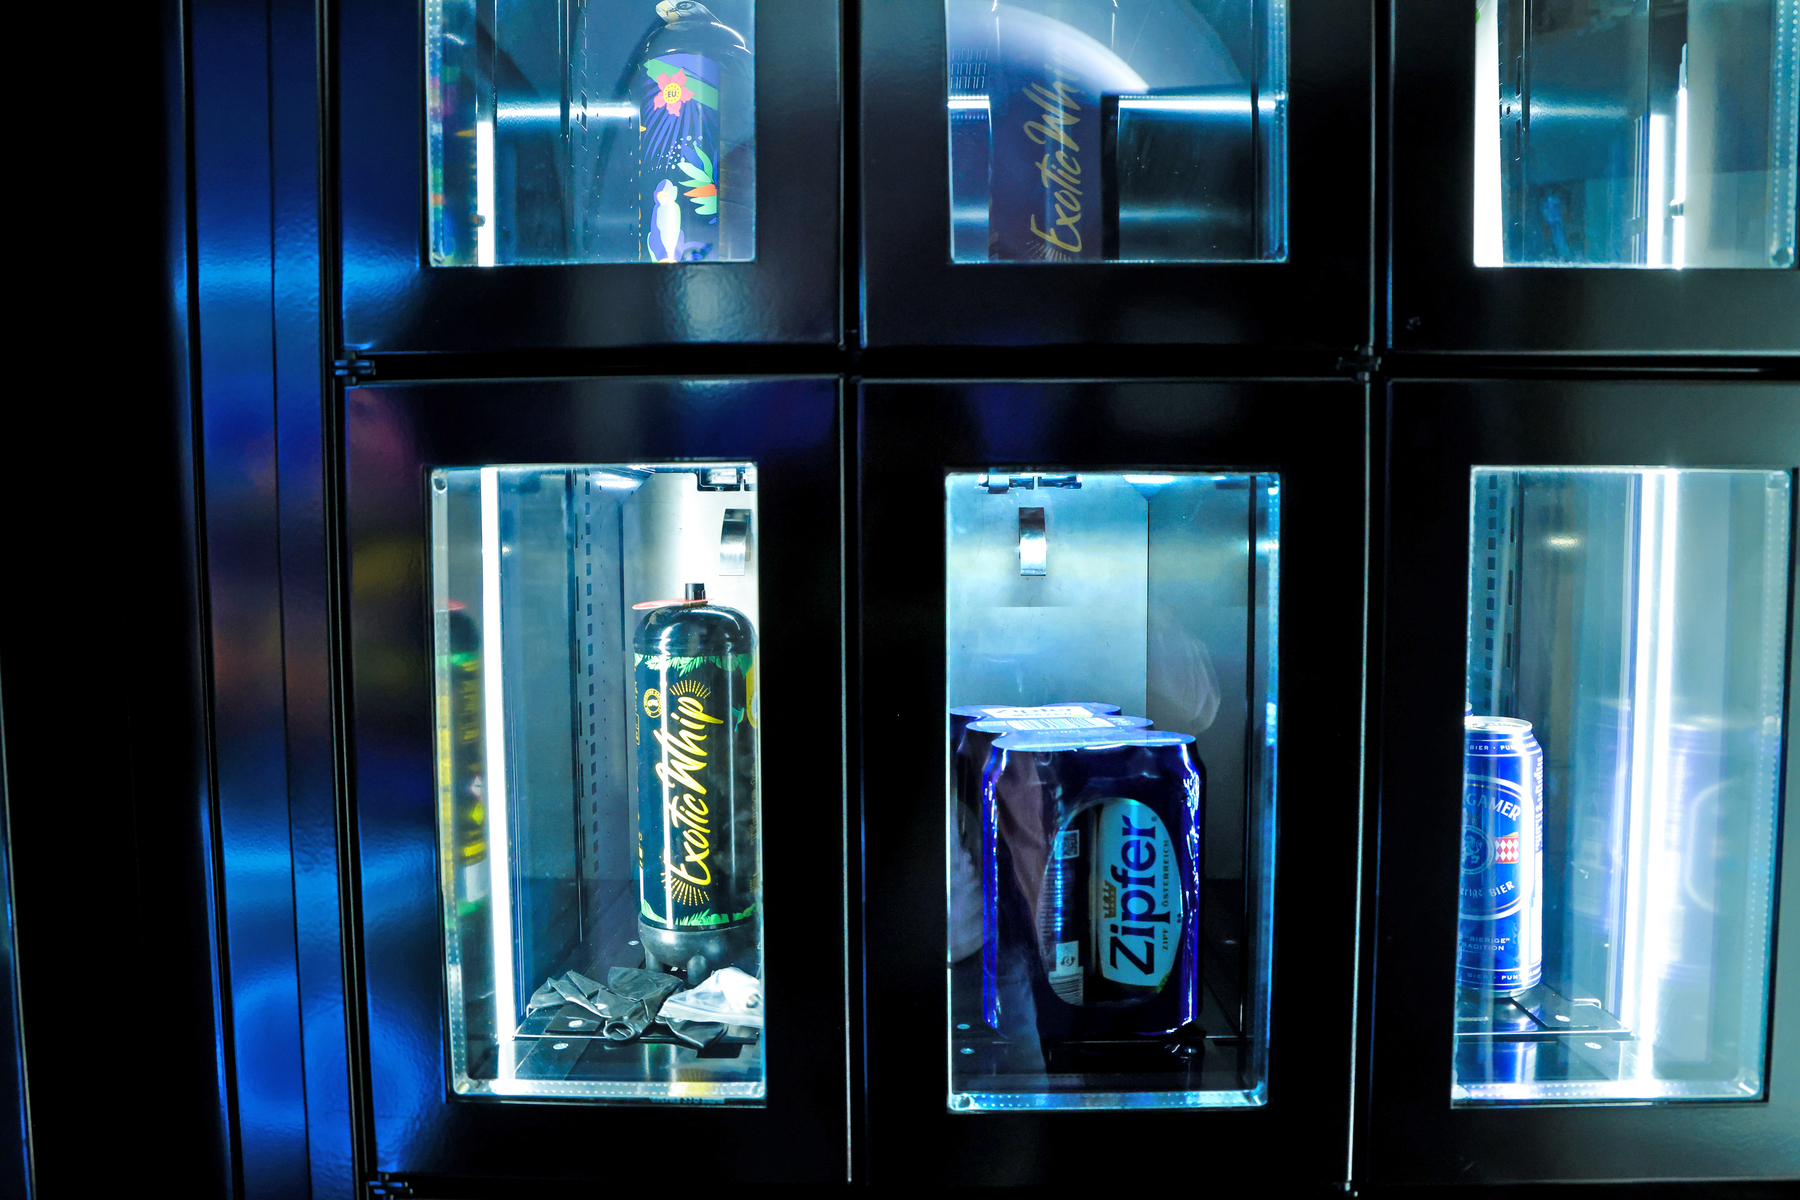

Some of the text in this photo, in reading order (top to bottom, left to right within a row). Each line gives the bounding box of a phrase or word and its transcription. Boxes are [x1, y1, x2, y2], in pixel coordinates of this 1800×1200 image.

[667, 90, 677, 98] EU
[1022, 50, 1083, 253] Exotic Whi
[653, 696, 724, 886] Exotic Whip
[1464, 792, 1521, 822] GAMER
[1107, 815, 1171, 976] Zipfer
[1160, 839, 1170, 951] ZIPF ÖSTERREICH
[1489, 880, 1515, 898] BIER
